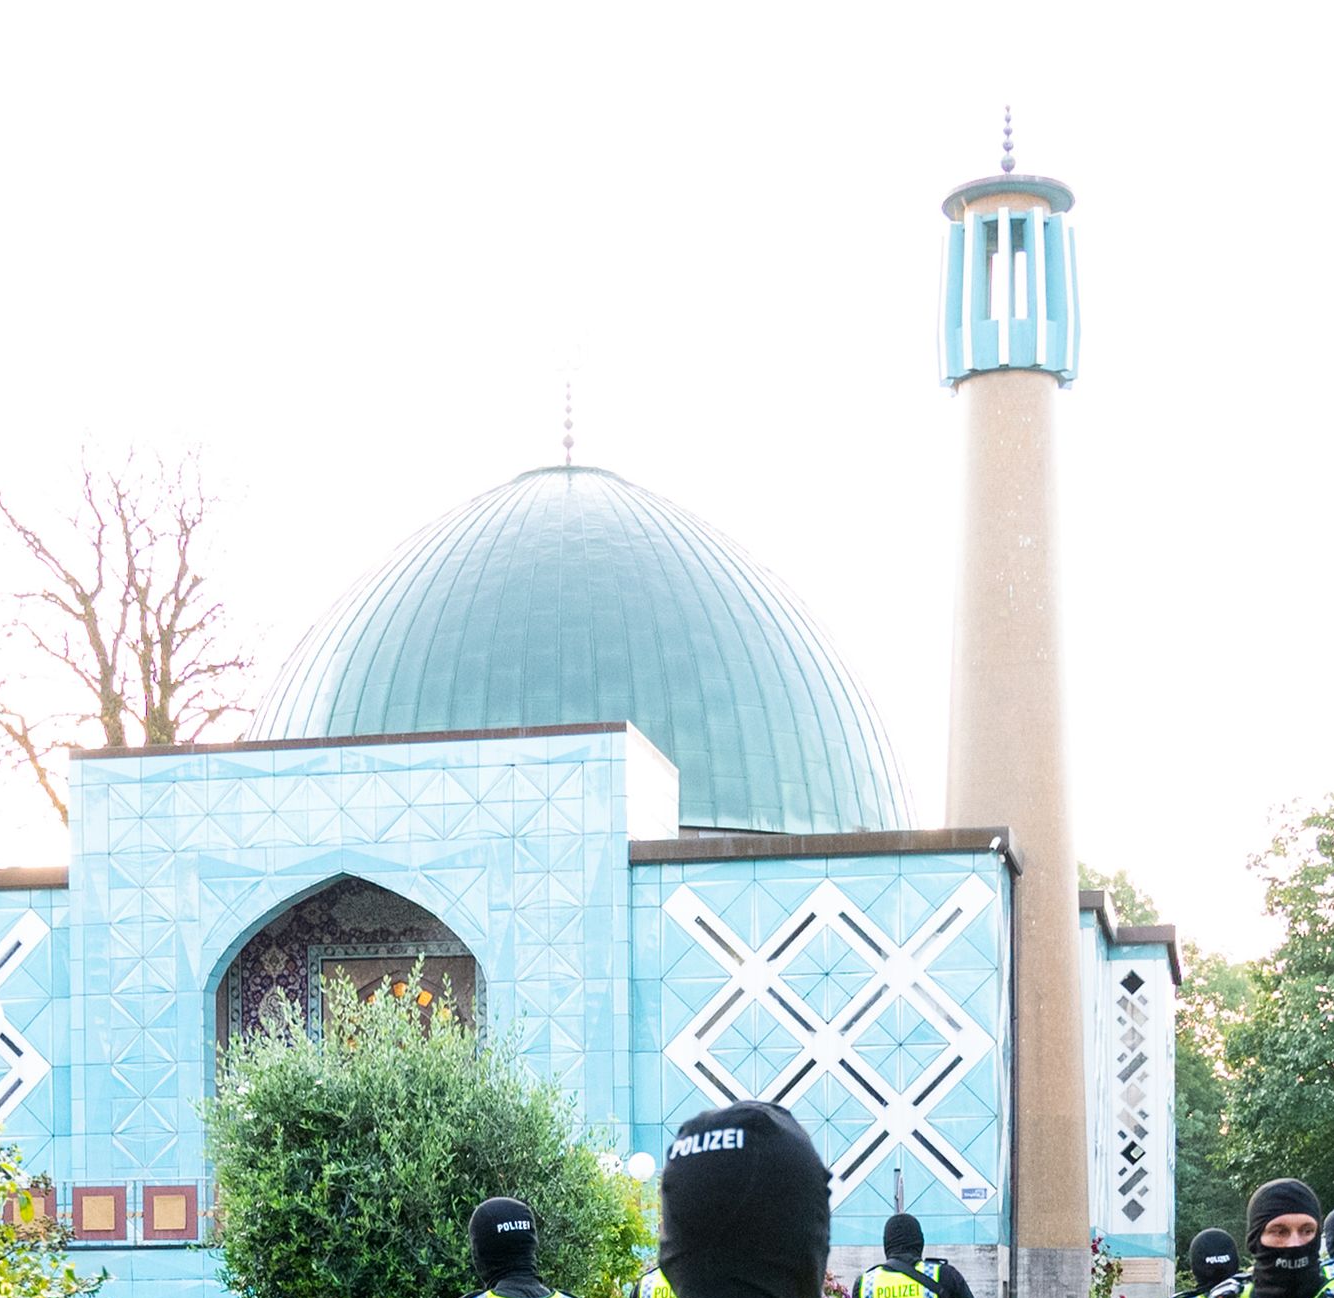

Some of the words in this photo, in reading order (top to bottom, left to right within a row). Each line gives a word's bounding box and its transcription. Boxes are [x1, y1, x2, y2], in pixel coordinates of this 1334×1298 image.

[669, 1128, 745, 1160] POLIZEI
[497, 1220, 532, 1233] POLIZEI
[1275, 1256, 1310, 1270] POLIZEI
